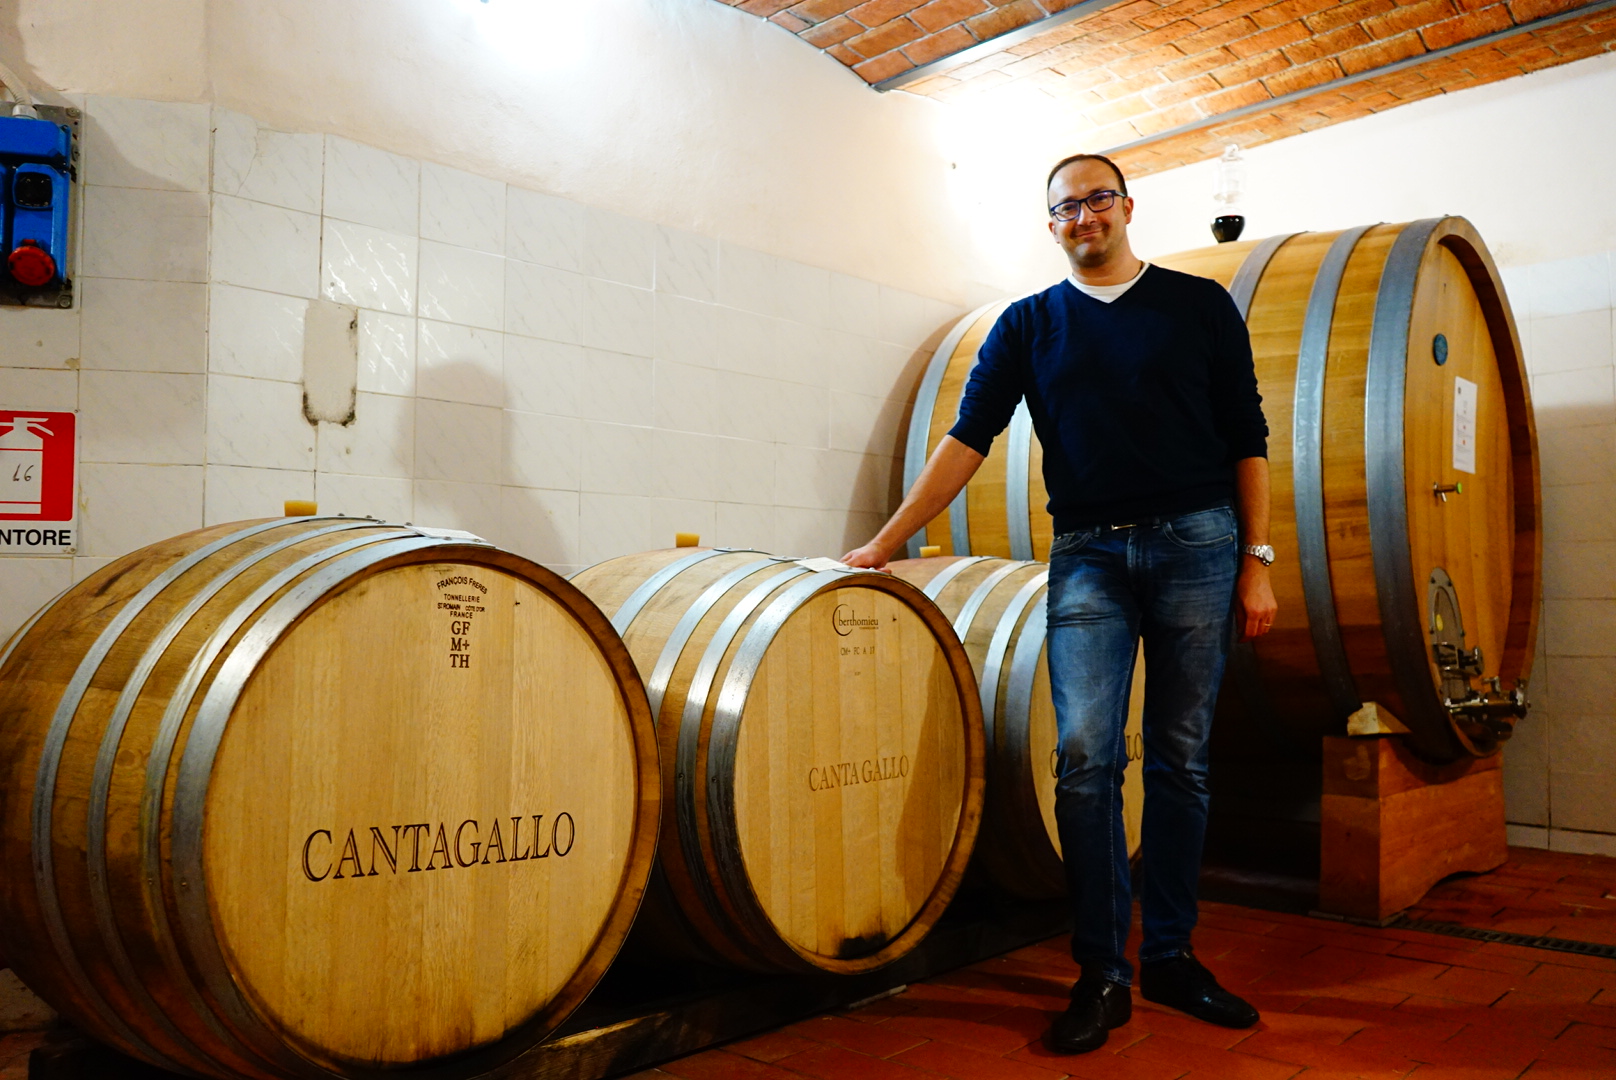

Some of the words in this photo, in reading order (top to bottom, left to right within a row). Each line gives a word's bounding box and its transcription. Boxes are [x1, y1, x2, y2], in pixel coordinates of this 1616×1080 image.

[444, 594, 480, 603] TONNELLERIE
[450, 611, 473, 619] FRANCE
[451, 620, 471, 636] GF
[450, 637, 470, 652] M+
[449, 653, 471, 669] TH
[808, 754, 910, 792] CANTAGALLO
[301, 811, 576, 882] CANTAGALLO
